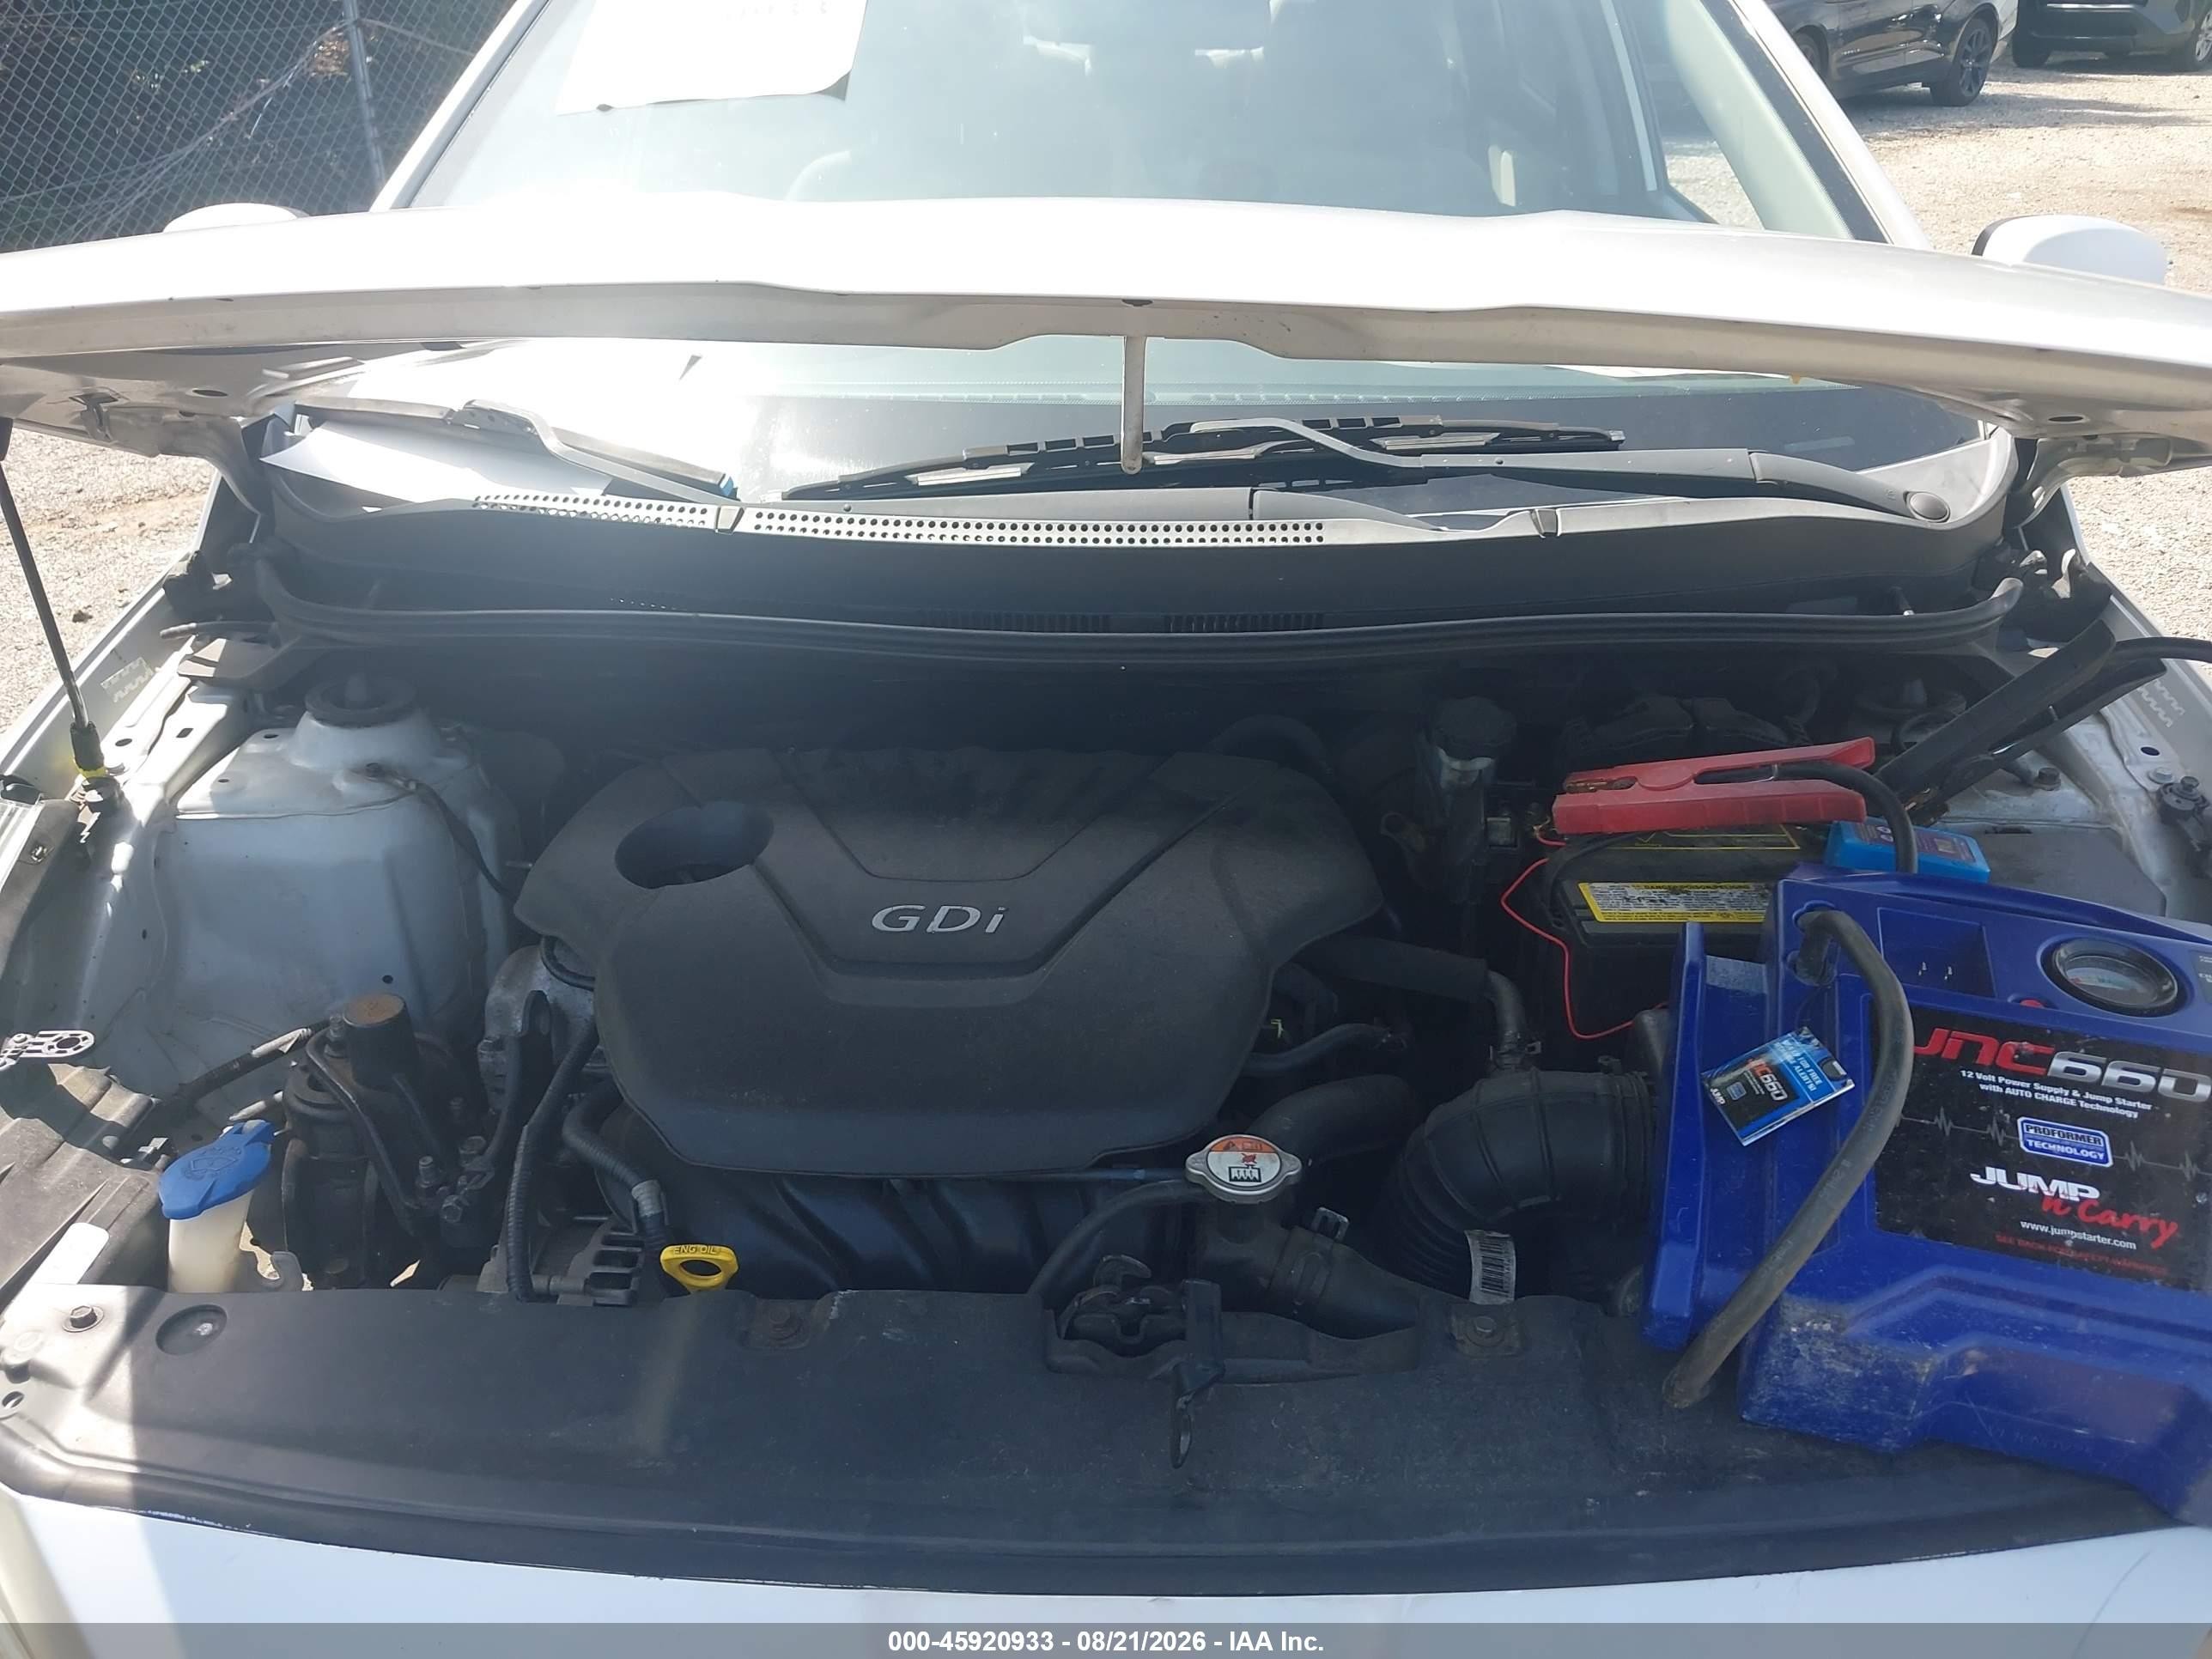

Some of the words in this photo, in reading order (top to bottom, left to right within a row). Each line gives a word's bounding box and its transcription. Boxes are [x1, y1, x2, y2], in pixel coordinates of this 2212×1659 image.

[871, 904, 1006, 933] GDi
[1805, 1069, 1823, 1085] FREE
[1960, 1070, 1975, 1079] 12
[1976, 1072, 1996, 1083] Volt
[1997, 1076, 2032, 1089] Power
[2033, 1082, 2070, 1097] Supply
[2071, 1089, 2081, 1097] &
[2082, 1091, 2113, 1104] Jump
[2114, 1097, 2153, 1110] Starter
[1978, 1083, 2004, 1093] with
[2005, 1086, 2033, 1098] AUTO
[2034, 1091, 2077, 1107] CHARGE
[2078, 1099, 2139, 1119] Technology
[2025, 1123, 2104, 1146] PROFORMER
[2027, 1138, 2106, 1160] TECHNOLOGY
[1970, 1166, 2100, 1201] JUMP
[2020, 1219, 2136, 1250] www.jumpstarter.com
[2077, 1198, 2179, 1249] Carry
[673, 1244, 696, 1255] ENG
[699, 1244, 718, 1255] OIL
